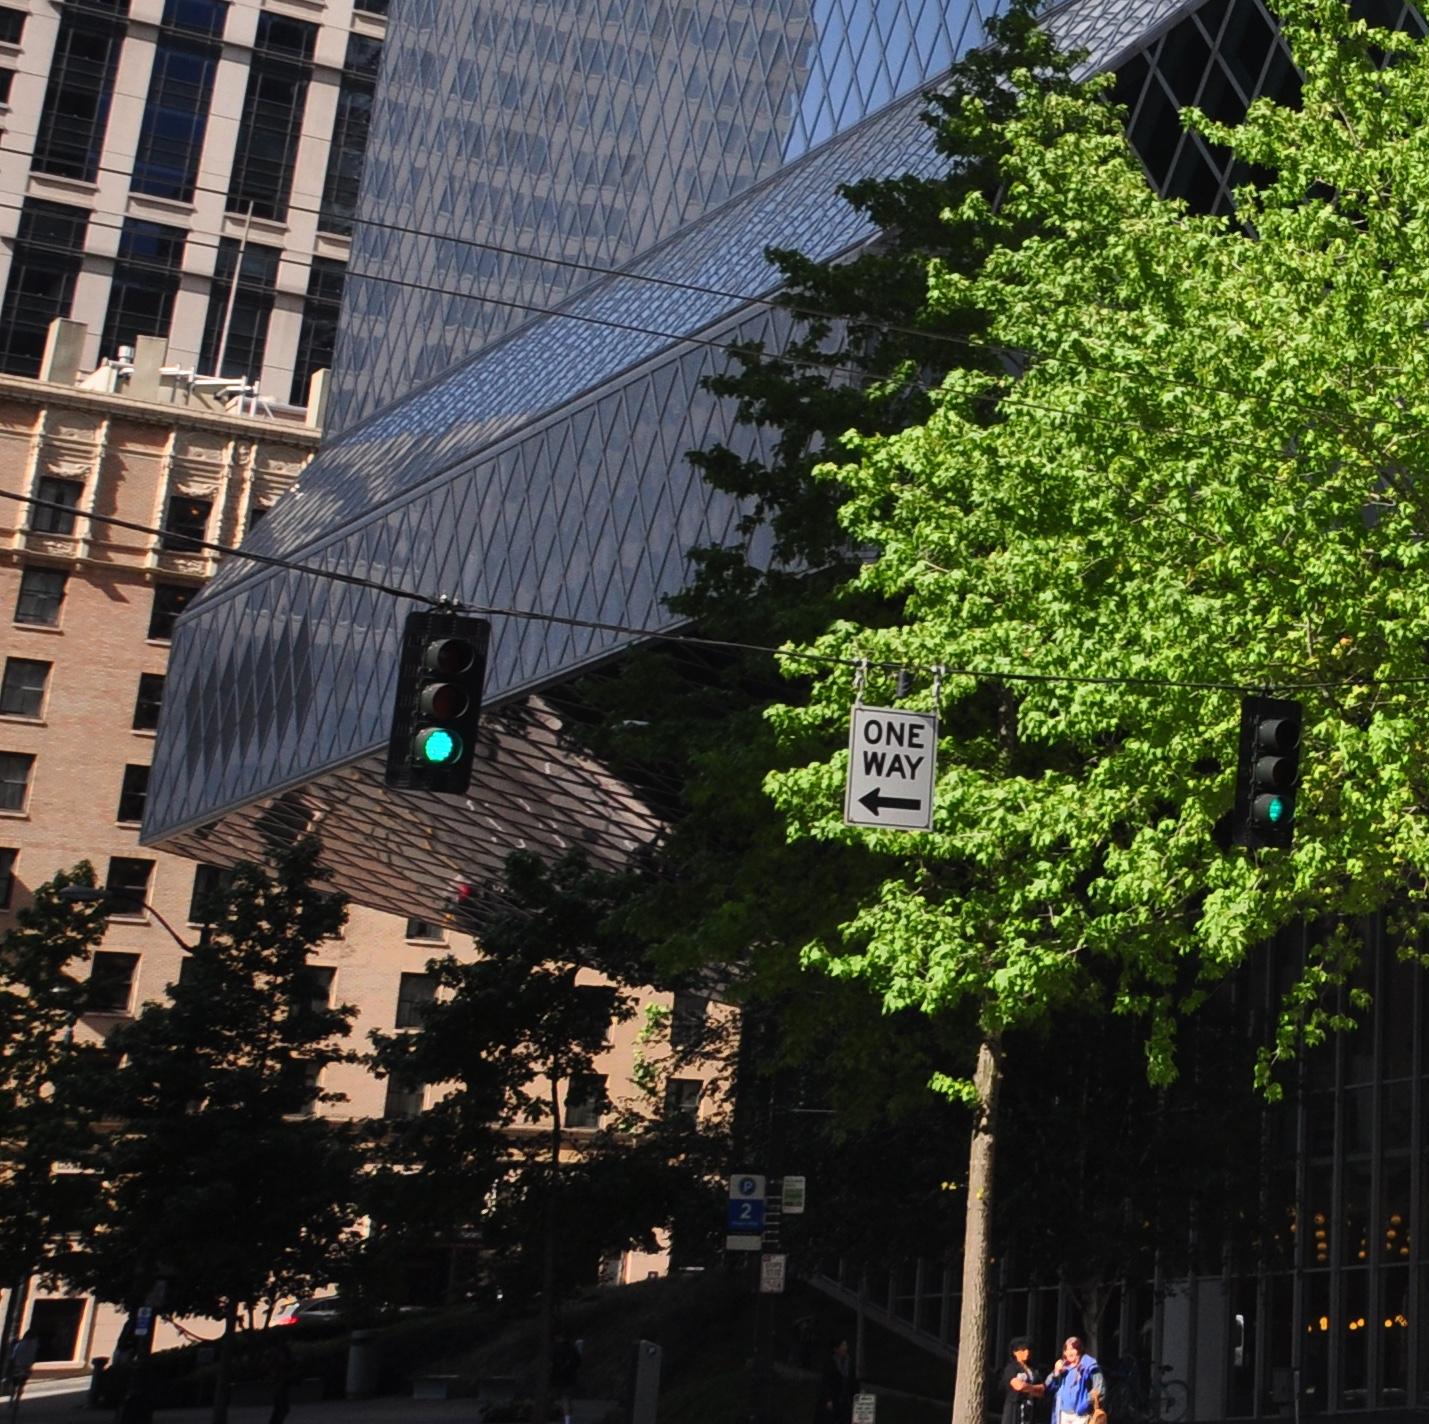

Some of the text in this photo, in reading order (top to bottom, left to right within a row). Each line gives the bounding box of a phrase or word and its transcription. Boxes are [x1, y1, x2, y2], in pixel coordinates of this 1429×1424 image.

[863, 719, 925, 749] ONE
[863, 750, 925, 780] WAY
[740, 1202, 752, 1219] 2
